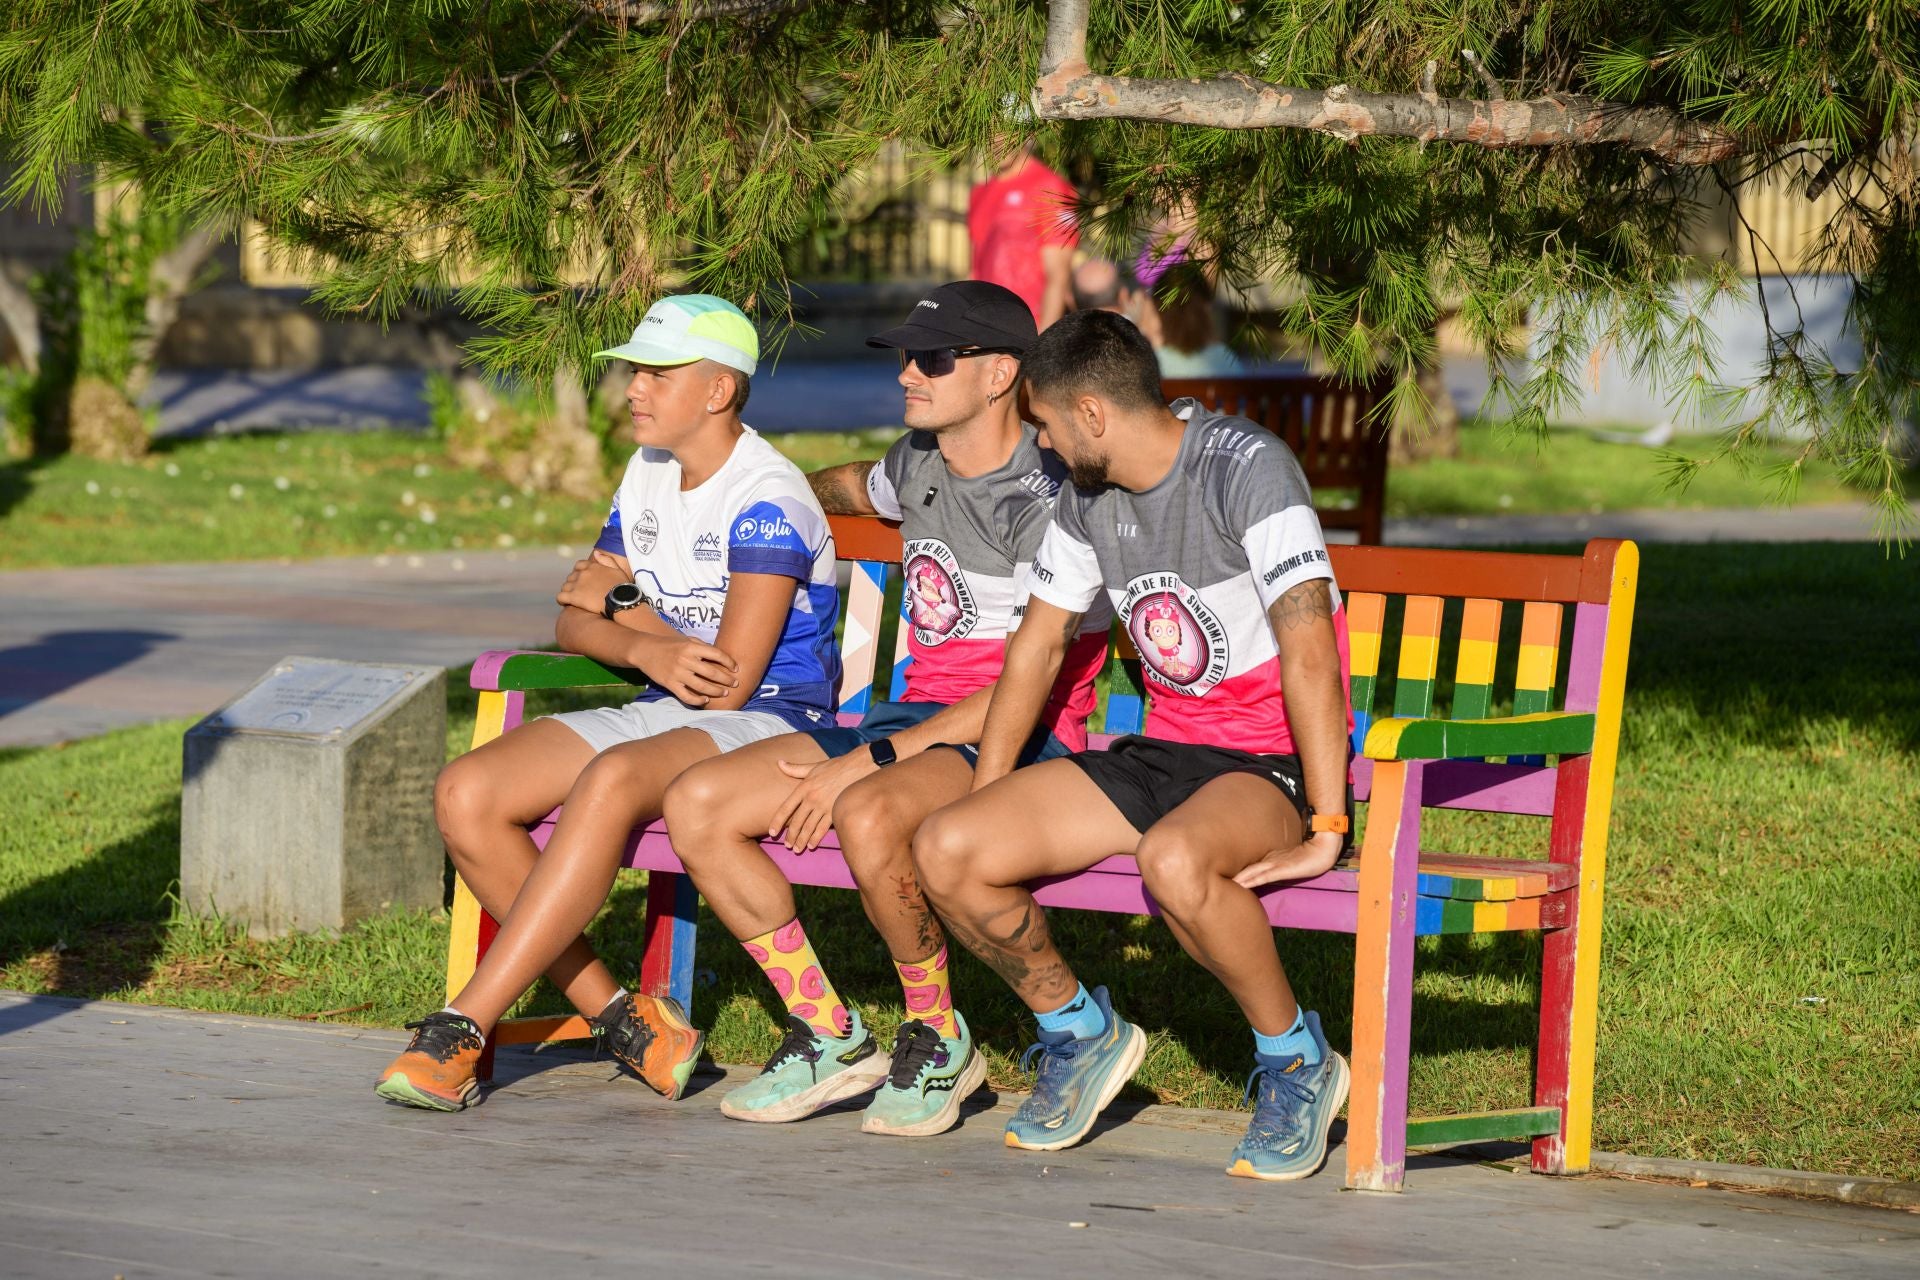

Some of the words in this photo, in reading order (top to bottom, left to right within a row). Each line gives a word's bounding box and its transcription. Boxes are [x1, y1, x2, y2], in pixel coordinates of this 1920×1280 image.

[933, 545, 951, 563] RETT
[1264, 555, 1302, 586] SINDROME
[1302, 550, 1314, 564] DE
[1315, 550, 1328, 563] RE
[1142, 577, 1156, 590] DE
[671, 604, 722, 623] NEVA
[1186, 594, 1224, 644] SINDROME
[1213, 648, 1226, 661] DE
[1206, 664, 1225, 684] RETT
